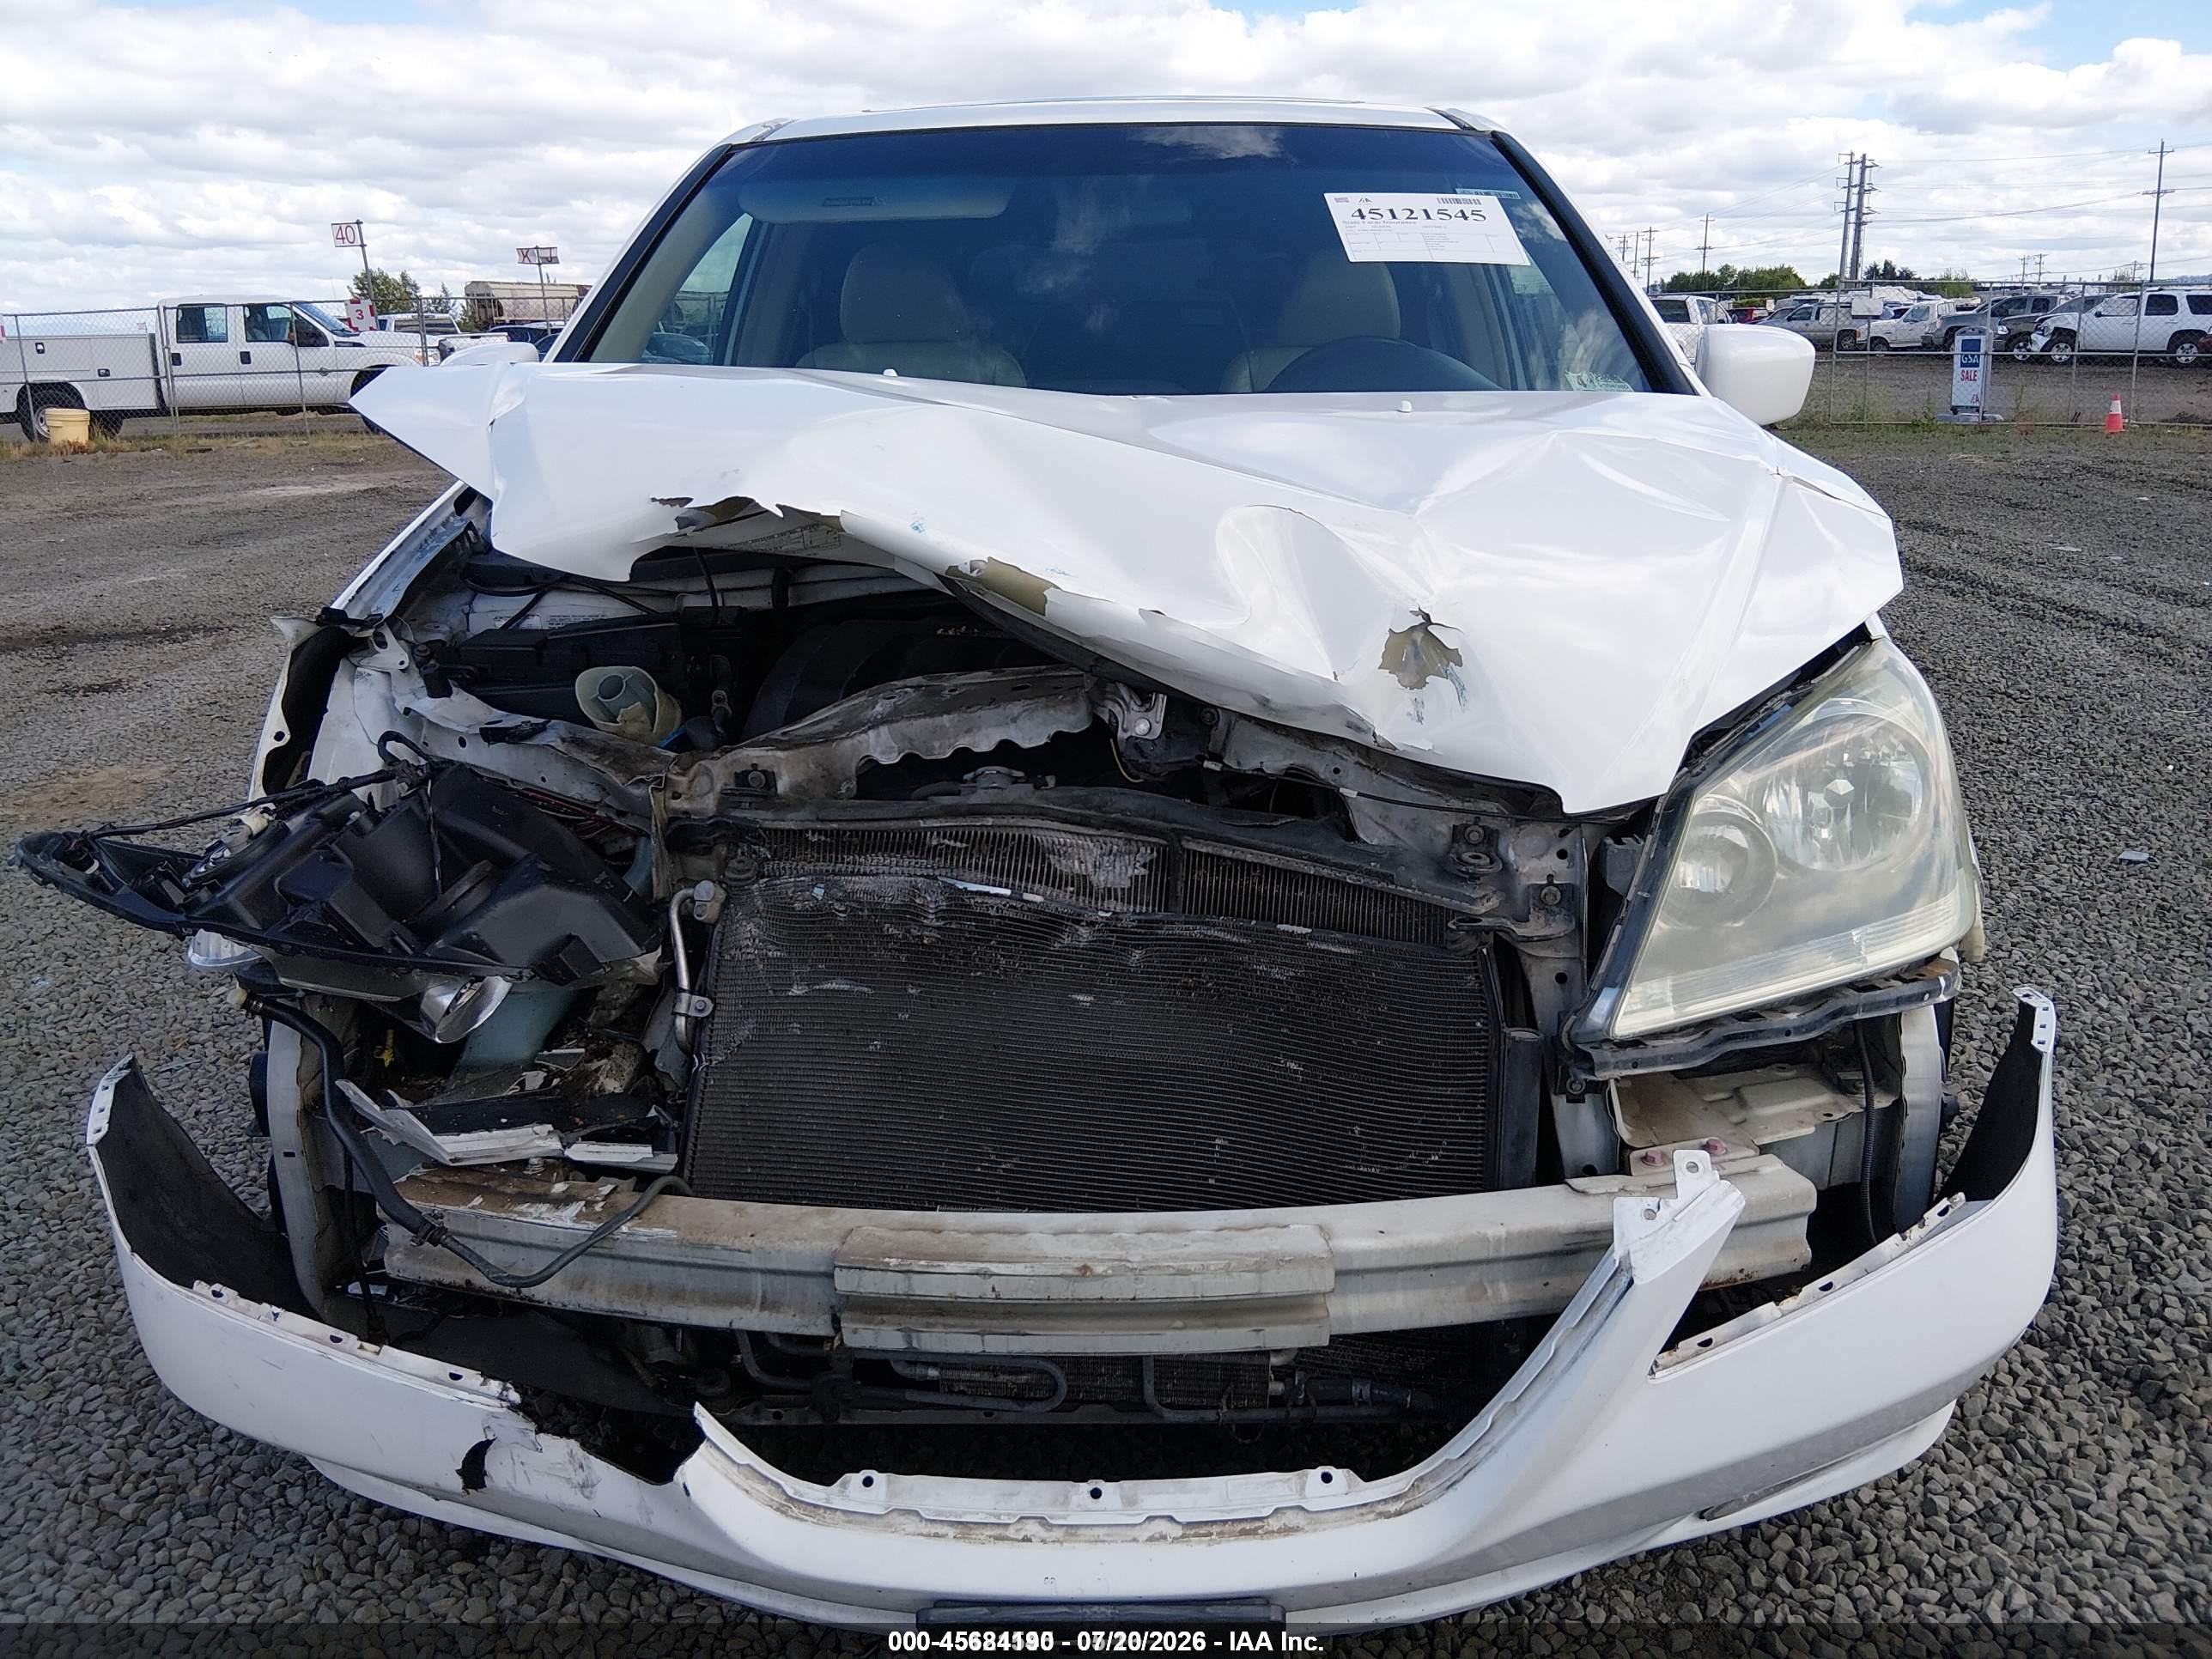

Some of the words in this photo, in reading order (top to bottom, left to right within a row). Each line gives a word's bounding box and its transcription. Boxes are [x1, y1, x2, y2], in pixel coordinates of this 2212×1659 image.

[1351, 208, 1486, 222] 45121545
[336, 225, 356, 245] 40
[520, 248, 532, 262] K
[356, 309, 364, 319] 3
[1961, 354, 1978, 363] GSA
[1960, 370, 1978, 381] SALE
